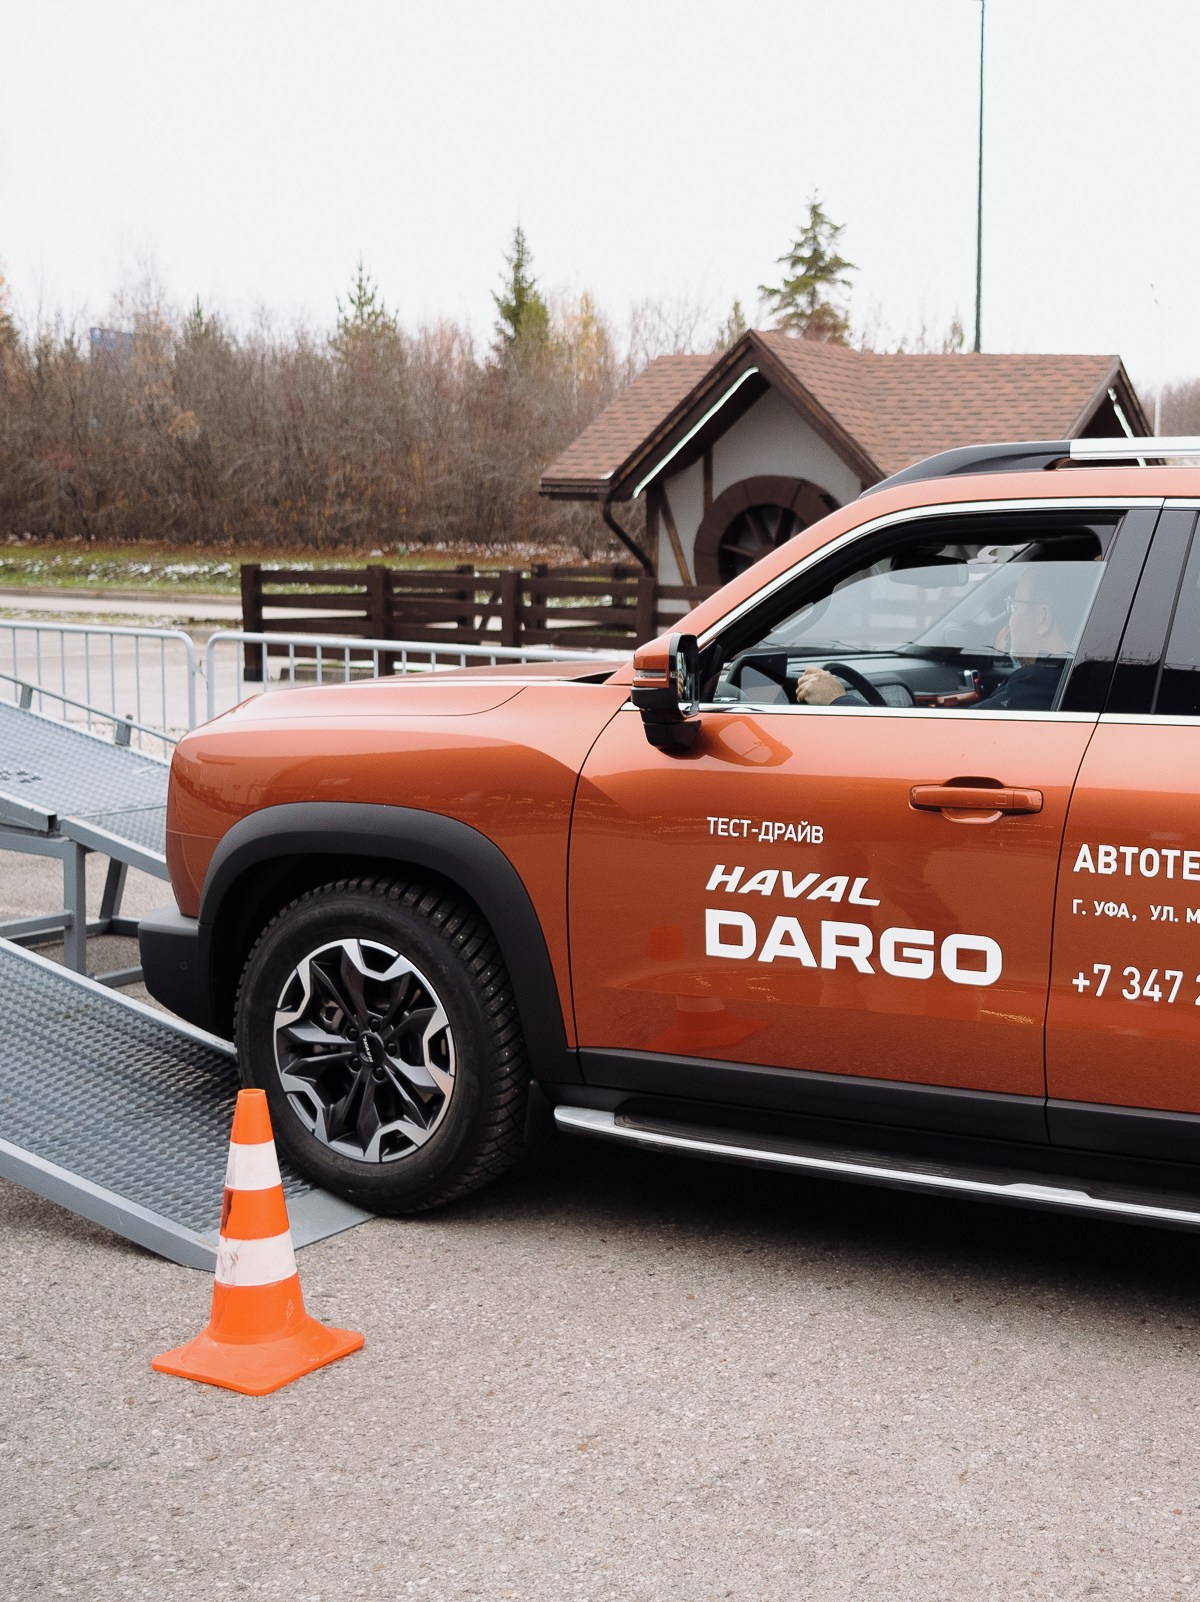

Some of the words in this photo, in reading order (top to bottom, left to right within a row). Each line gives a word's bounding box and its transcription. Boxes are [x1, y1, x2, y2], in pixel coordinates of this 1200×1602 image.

[706, 816, 824, 844] ТЕСТ-ДРАЙВ
[705, 864, 881, 907] HAVAL
[1072, 898, 1087, 916] Г.
[1093, 900, 1137, 922] УФА,
[1149, 904, 1179, 923] УЛ.
[704, 908, 1003, 987] DARGO
[1071, 963, 1112, 997] +7
[1121, 966, 1184, 1004] 347
[362, 1035, 374, 1063] HAVAL
